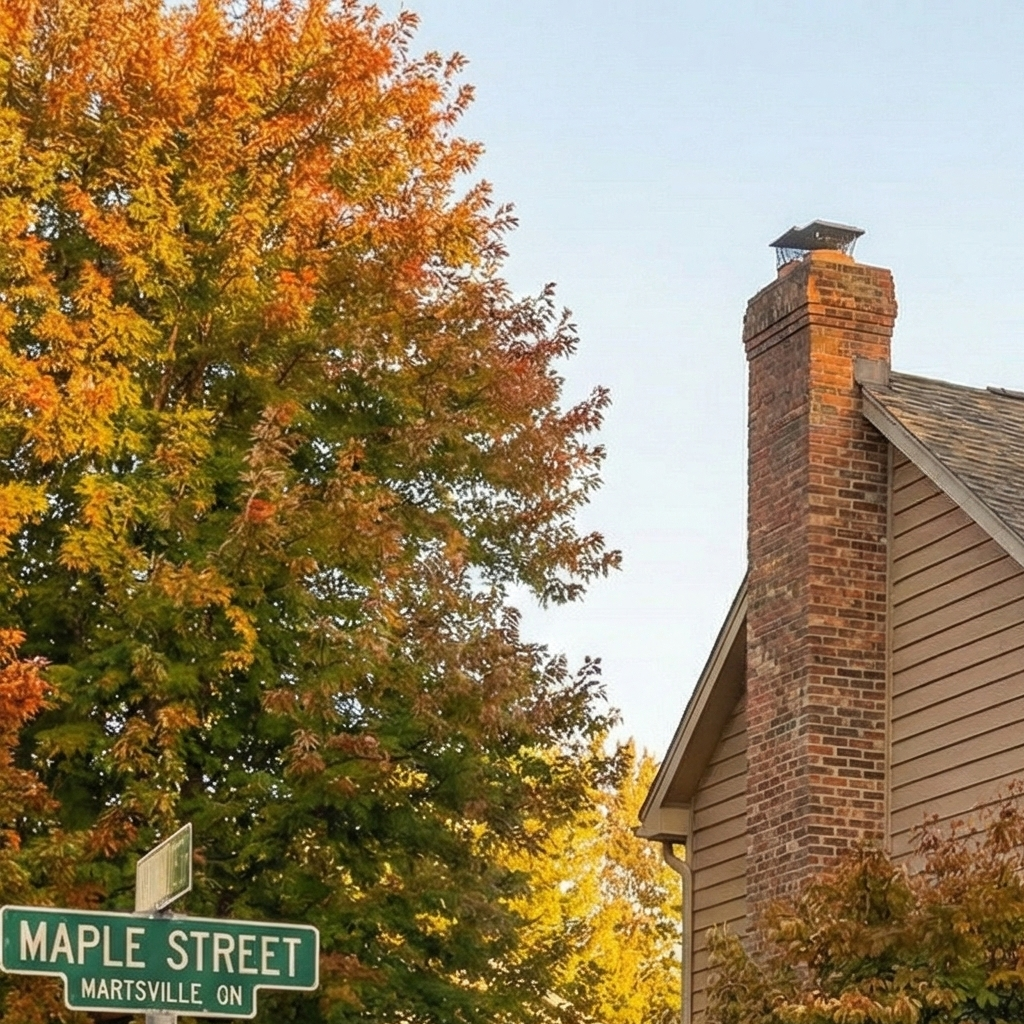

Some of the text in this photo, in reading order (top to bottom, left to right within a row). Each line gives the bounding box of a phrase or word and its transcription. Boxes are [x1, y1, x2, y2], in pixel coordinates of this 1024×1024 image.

[19, 919, 302, 978] MAPLE STREET
[81, 977, 243, 1007] MARTSVILLE ON
